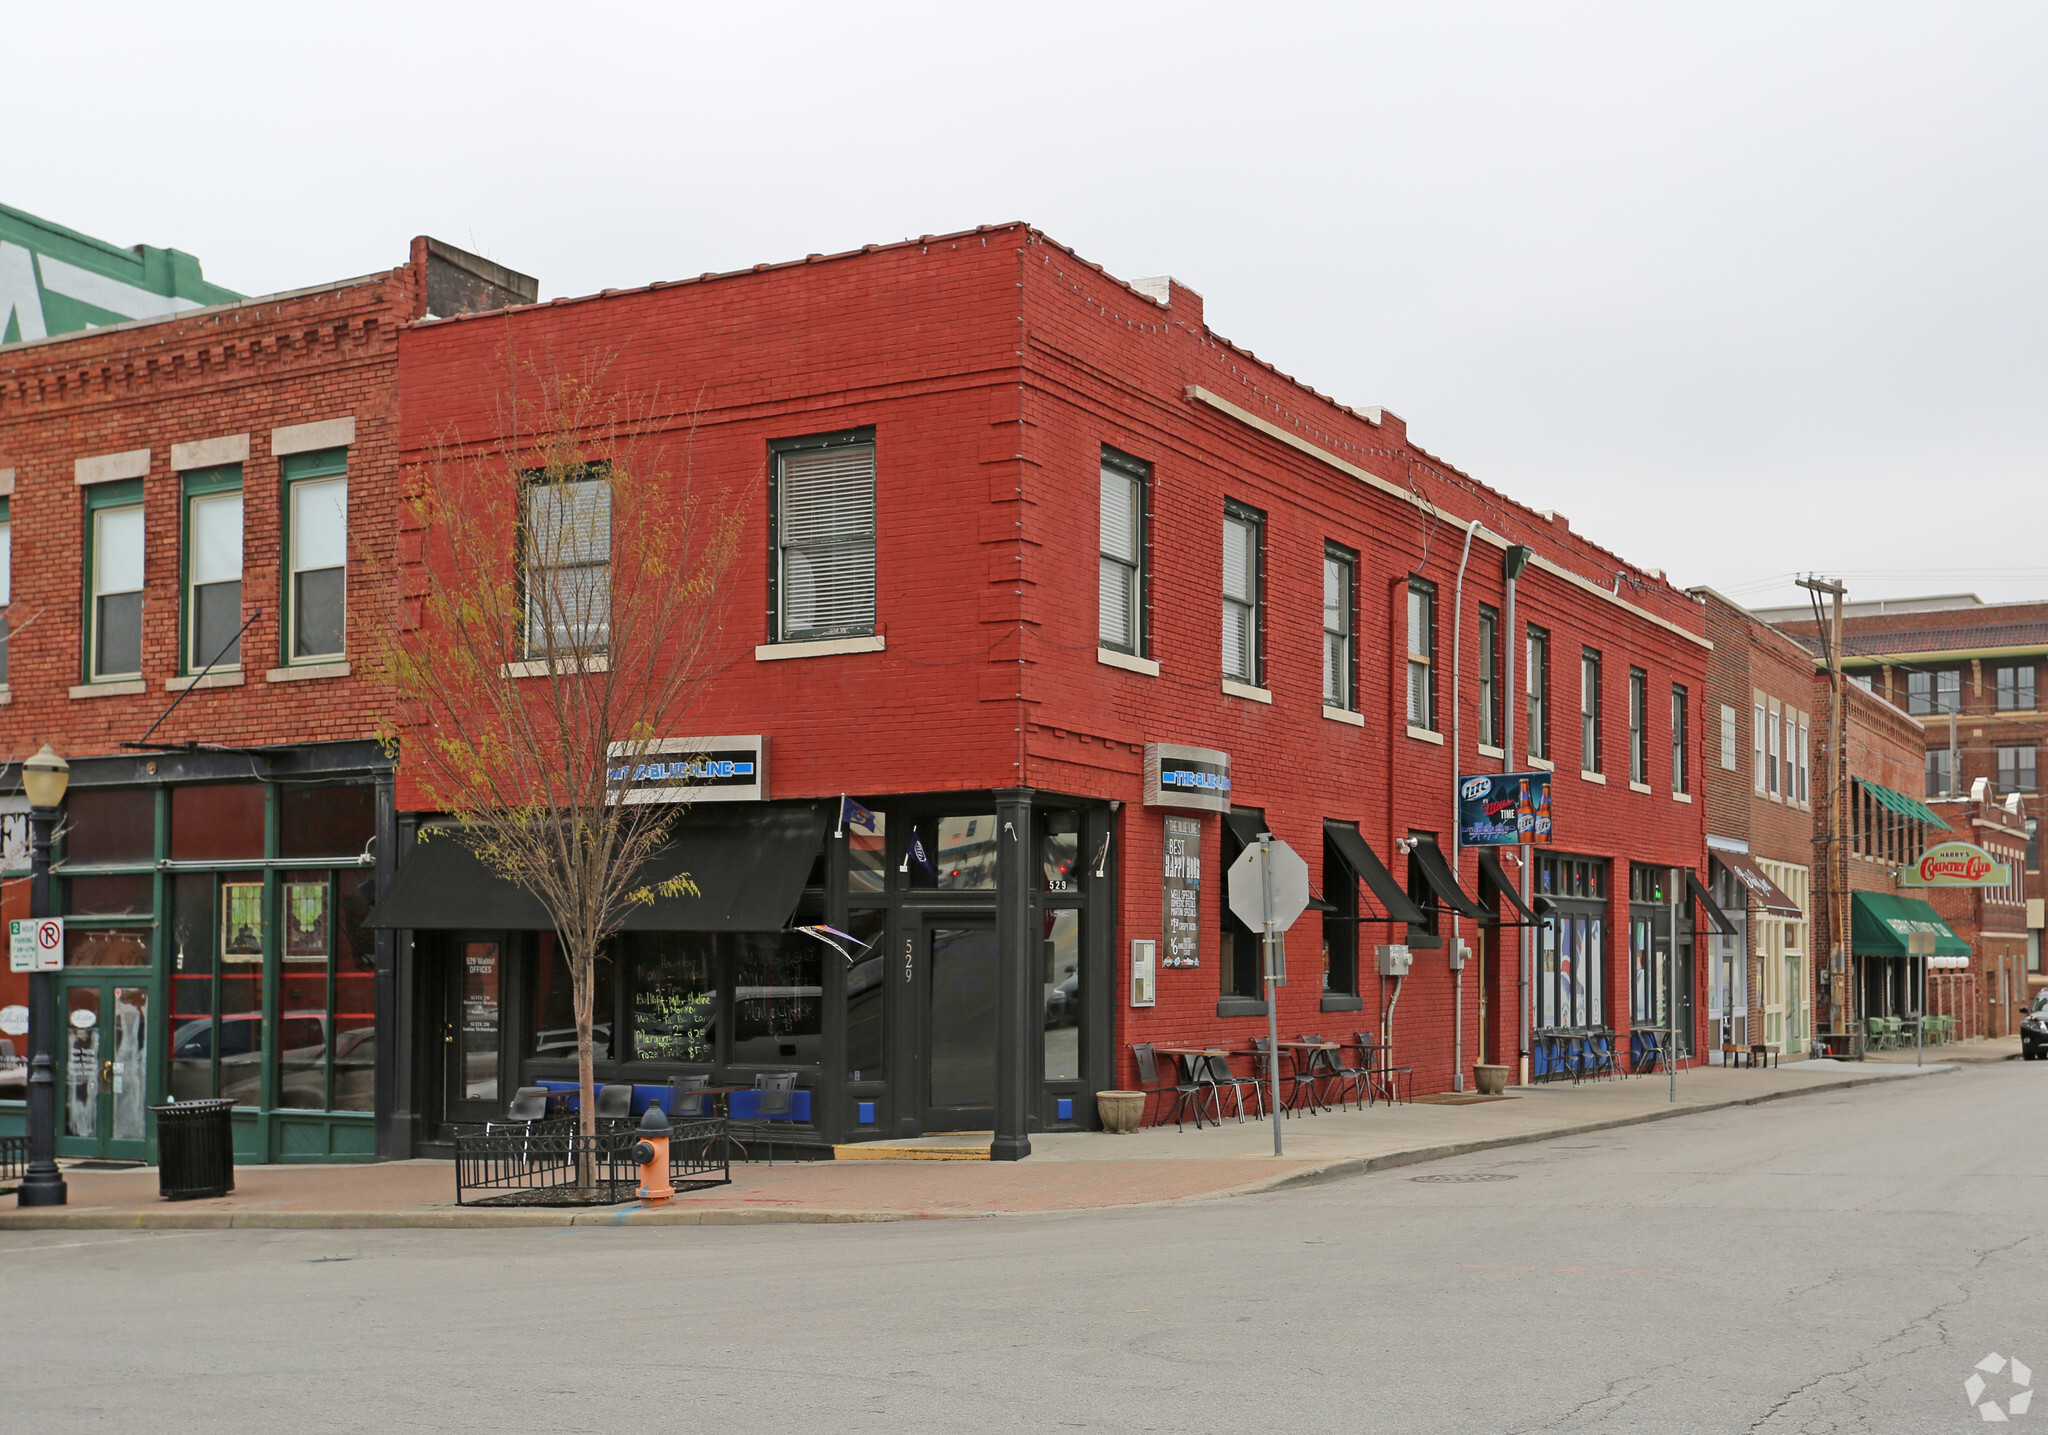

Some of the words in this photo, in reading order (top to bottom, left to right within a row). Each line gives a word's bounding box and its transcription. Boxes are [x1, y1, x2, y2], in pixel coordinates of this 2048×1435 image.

[696, 760, 734, 777] LINE
[1175, 770, 1195, 787] THE
[1500, 809, 1515, 819] TIME
[1169, 838, 1185, 856] BEST
[1165, 854, 1185, 878] HAPPY
[1920, 857, 1966, 881] COUNTRY
[1966, 856, 1991, 881] CLUB
[1049, 880, 1067, 890] 529
[13, 922, 19, 934] 2
[466, 957, 476, 965] 529
[905, 939, 913, 982] 529
[469, 965, 492, 974] OFFICES
